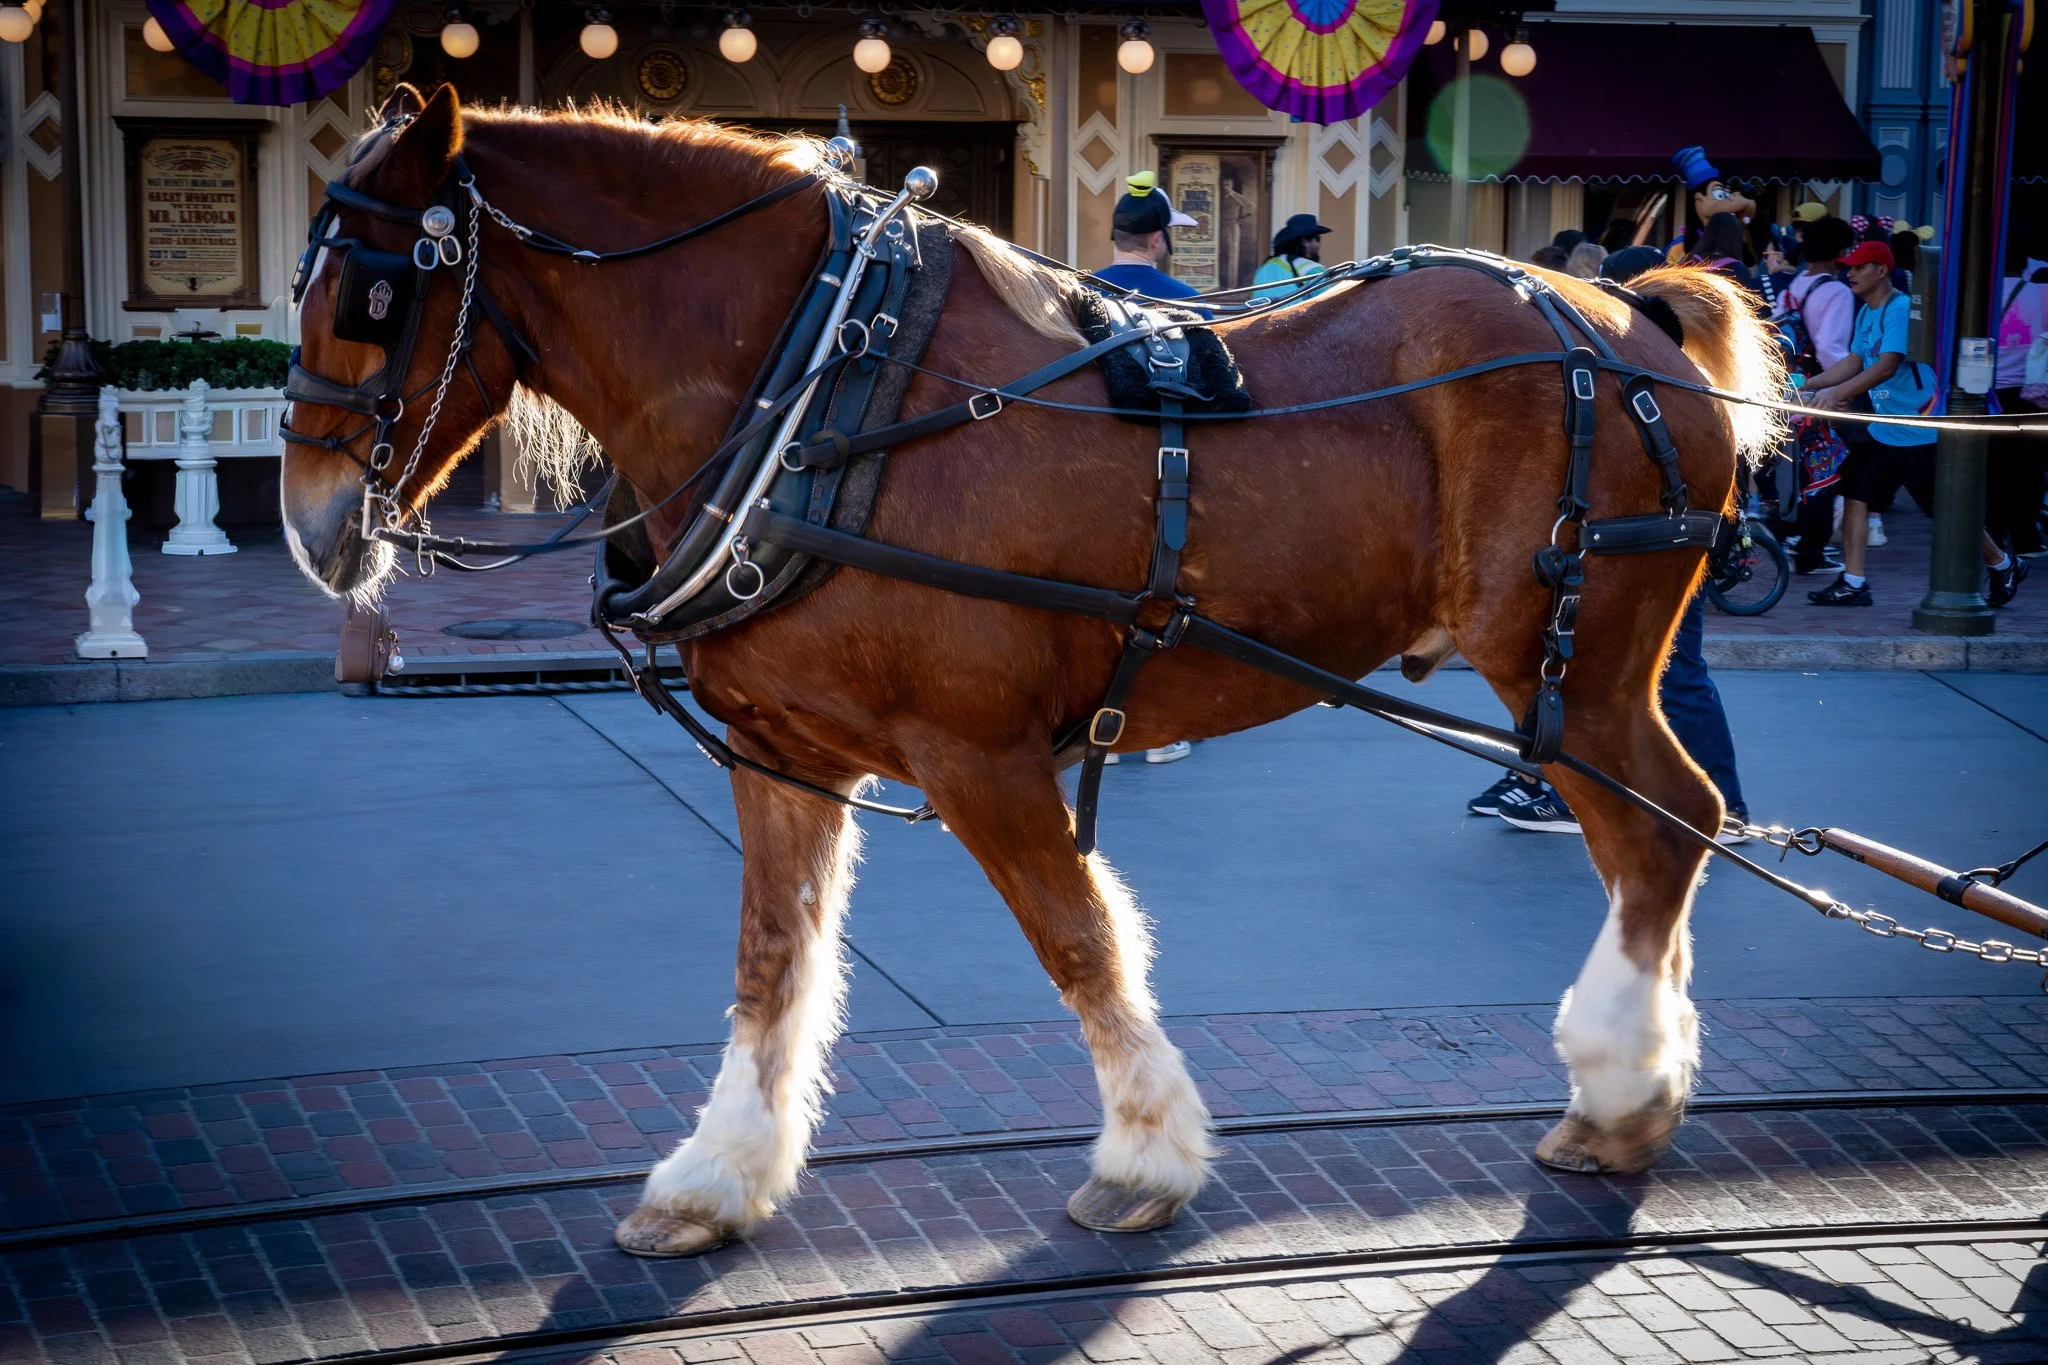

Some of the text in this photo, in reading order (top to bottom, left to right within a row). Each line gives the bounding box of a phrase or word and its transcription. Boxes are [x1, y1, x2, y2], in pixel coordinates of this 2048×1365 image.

[148, 192, 236, 203] GREAT MOMENTS
[148, 210, 235, 223] MR. LINCOLN
